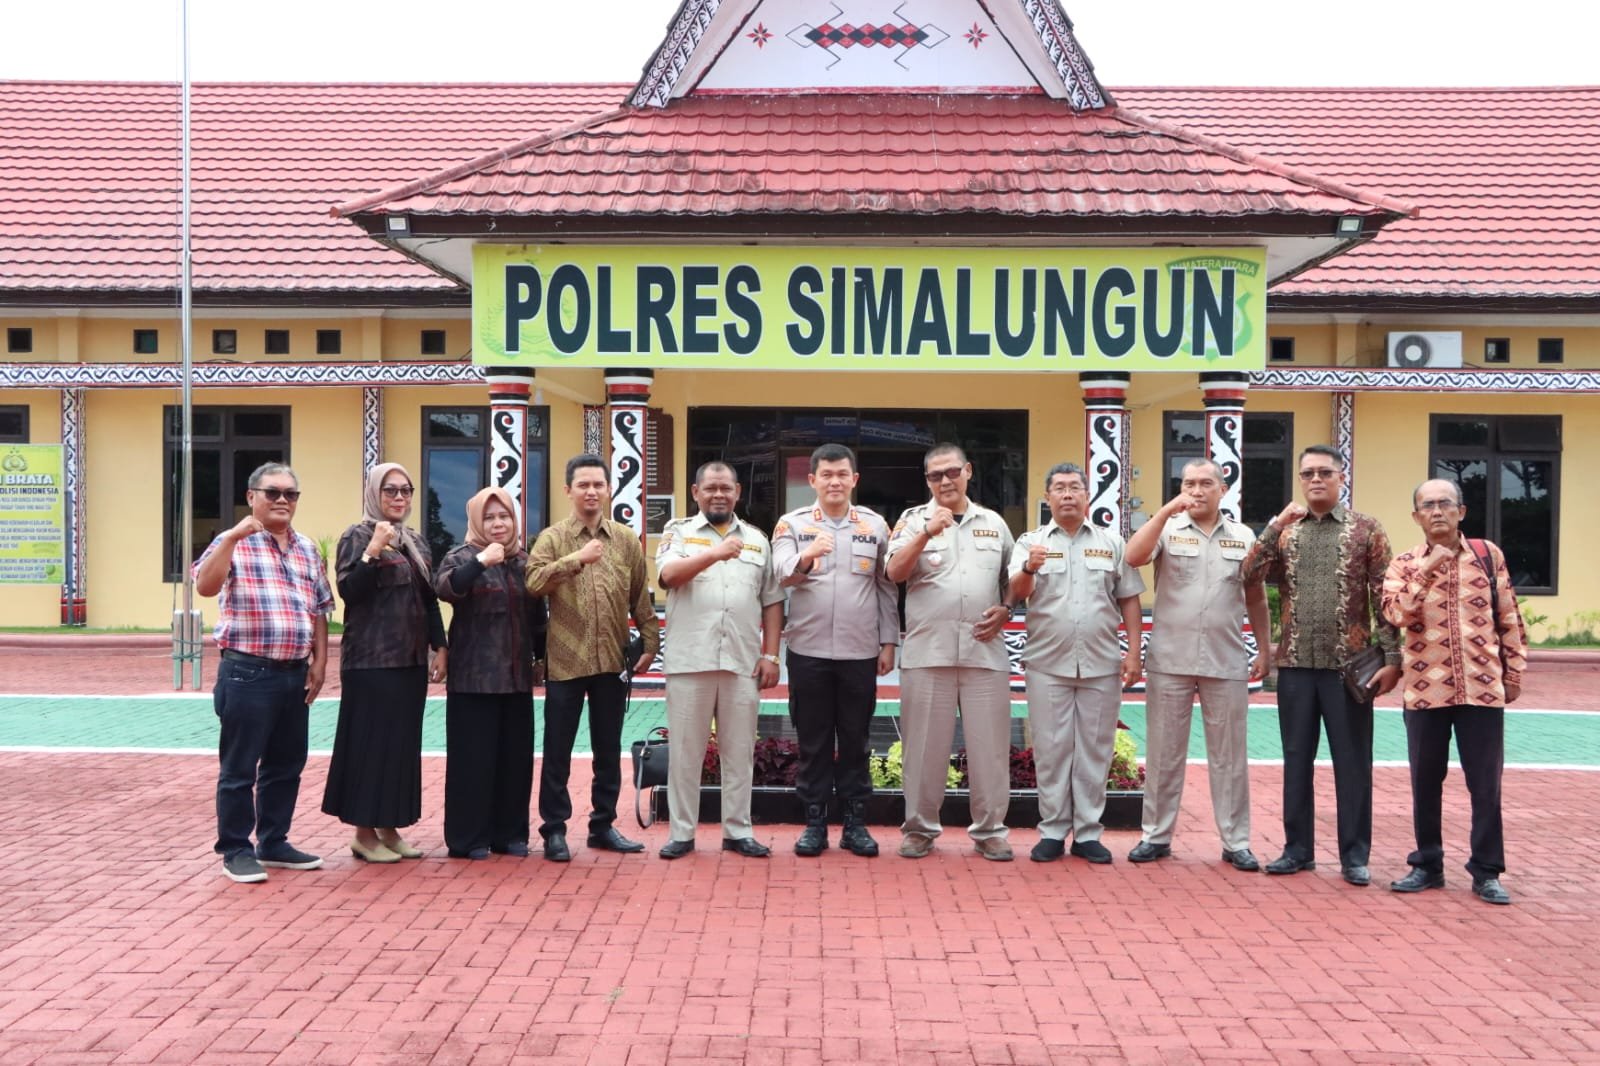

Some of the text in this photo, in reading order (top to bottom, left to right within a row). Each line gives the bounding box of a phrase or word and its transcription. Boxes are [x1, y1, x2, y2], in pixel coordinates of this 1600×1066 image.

[504, 263, 1235, 358] POLRES SIMALUNGUN
[6, 474, 54, 485] BRATA
[20, 487, 59, 495] INDONESIA
[852, 534, 877, 545] POLRI
